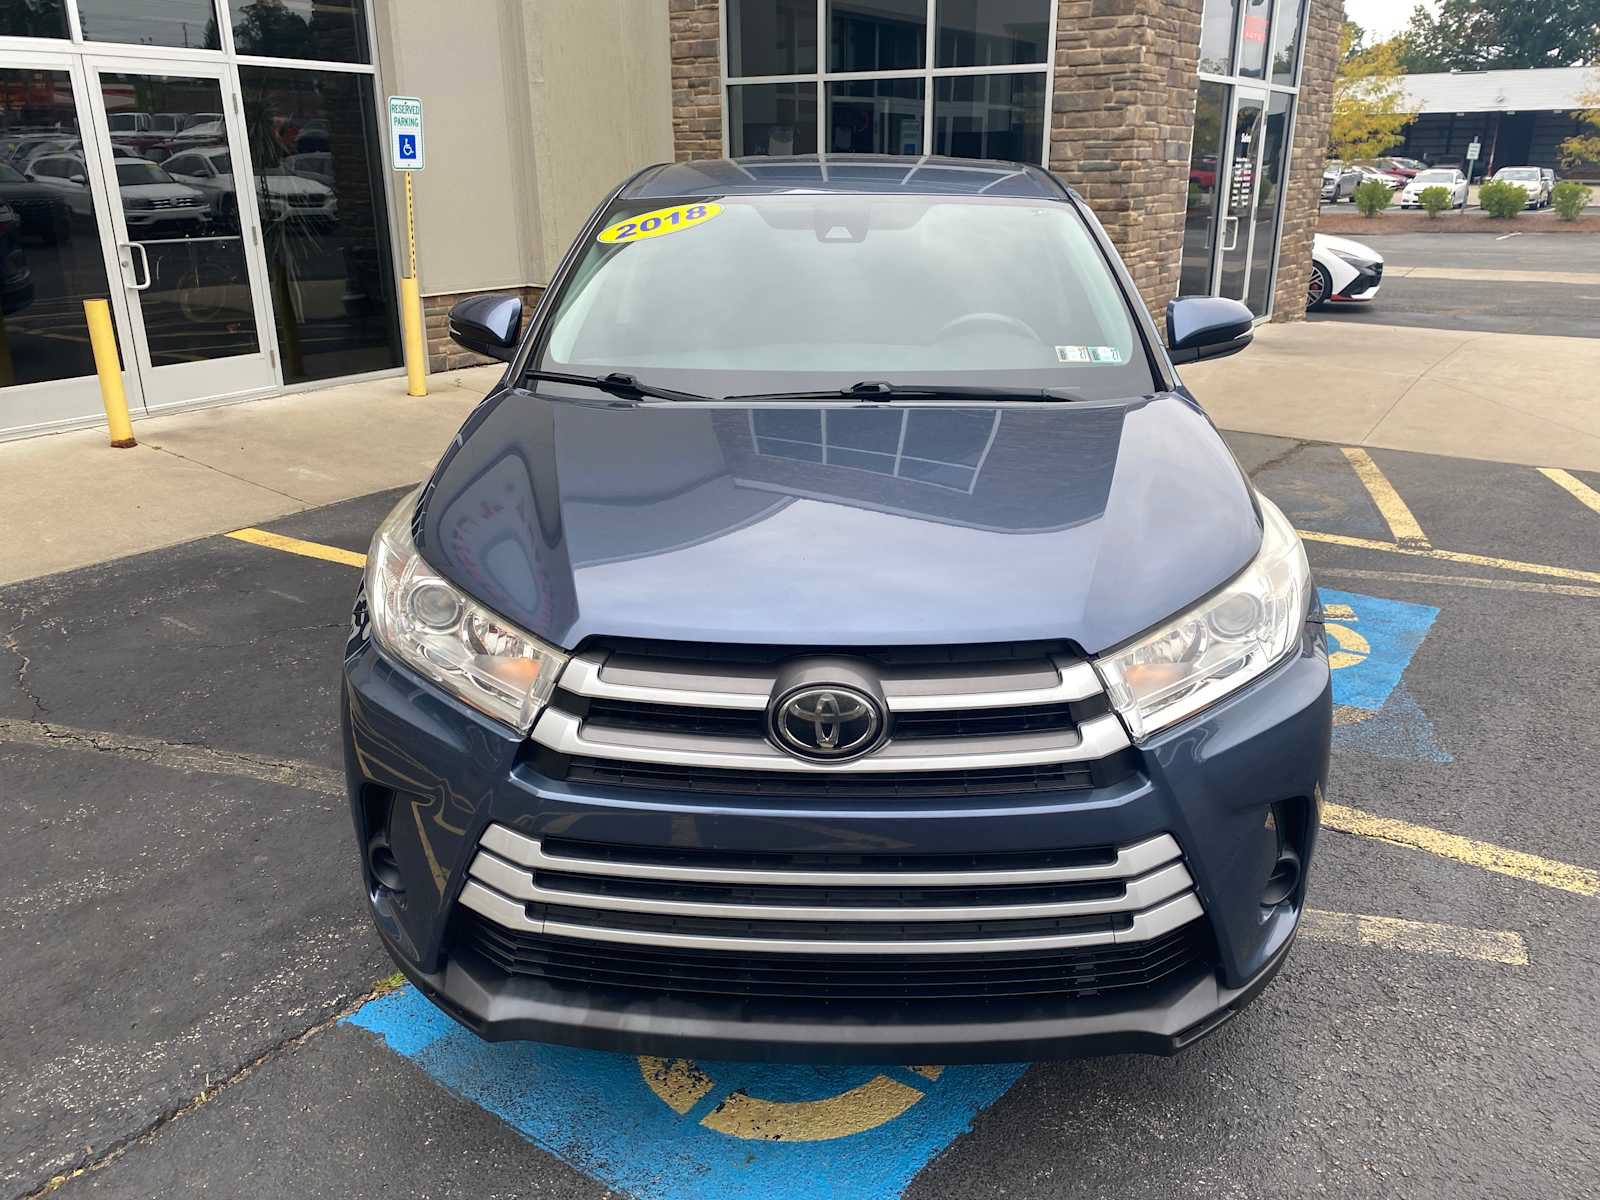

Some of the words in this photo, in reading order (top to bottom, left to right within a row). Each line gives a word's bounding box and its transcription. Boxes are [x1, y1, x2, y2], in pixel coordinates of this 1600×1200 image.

[391, 104, 420, 115] RESERVED
[393, 116, 419, 127] PARKING
[615, 206, 707, 240] 2018
